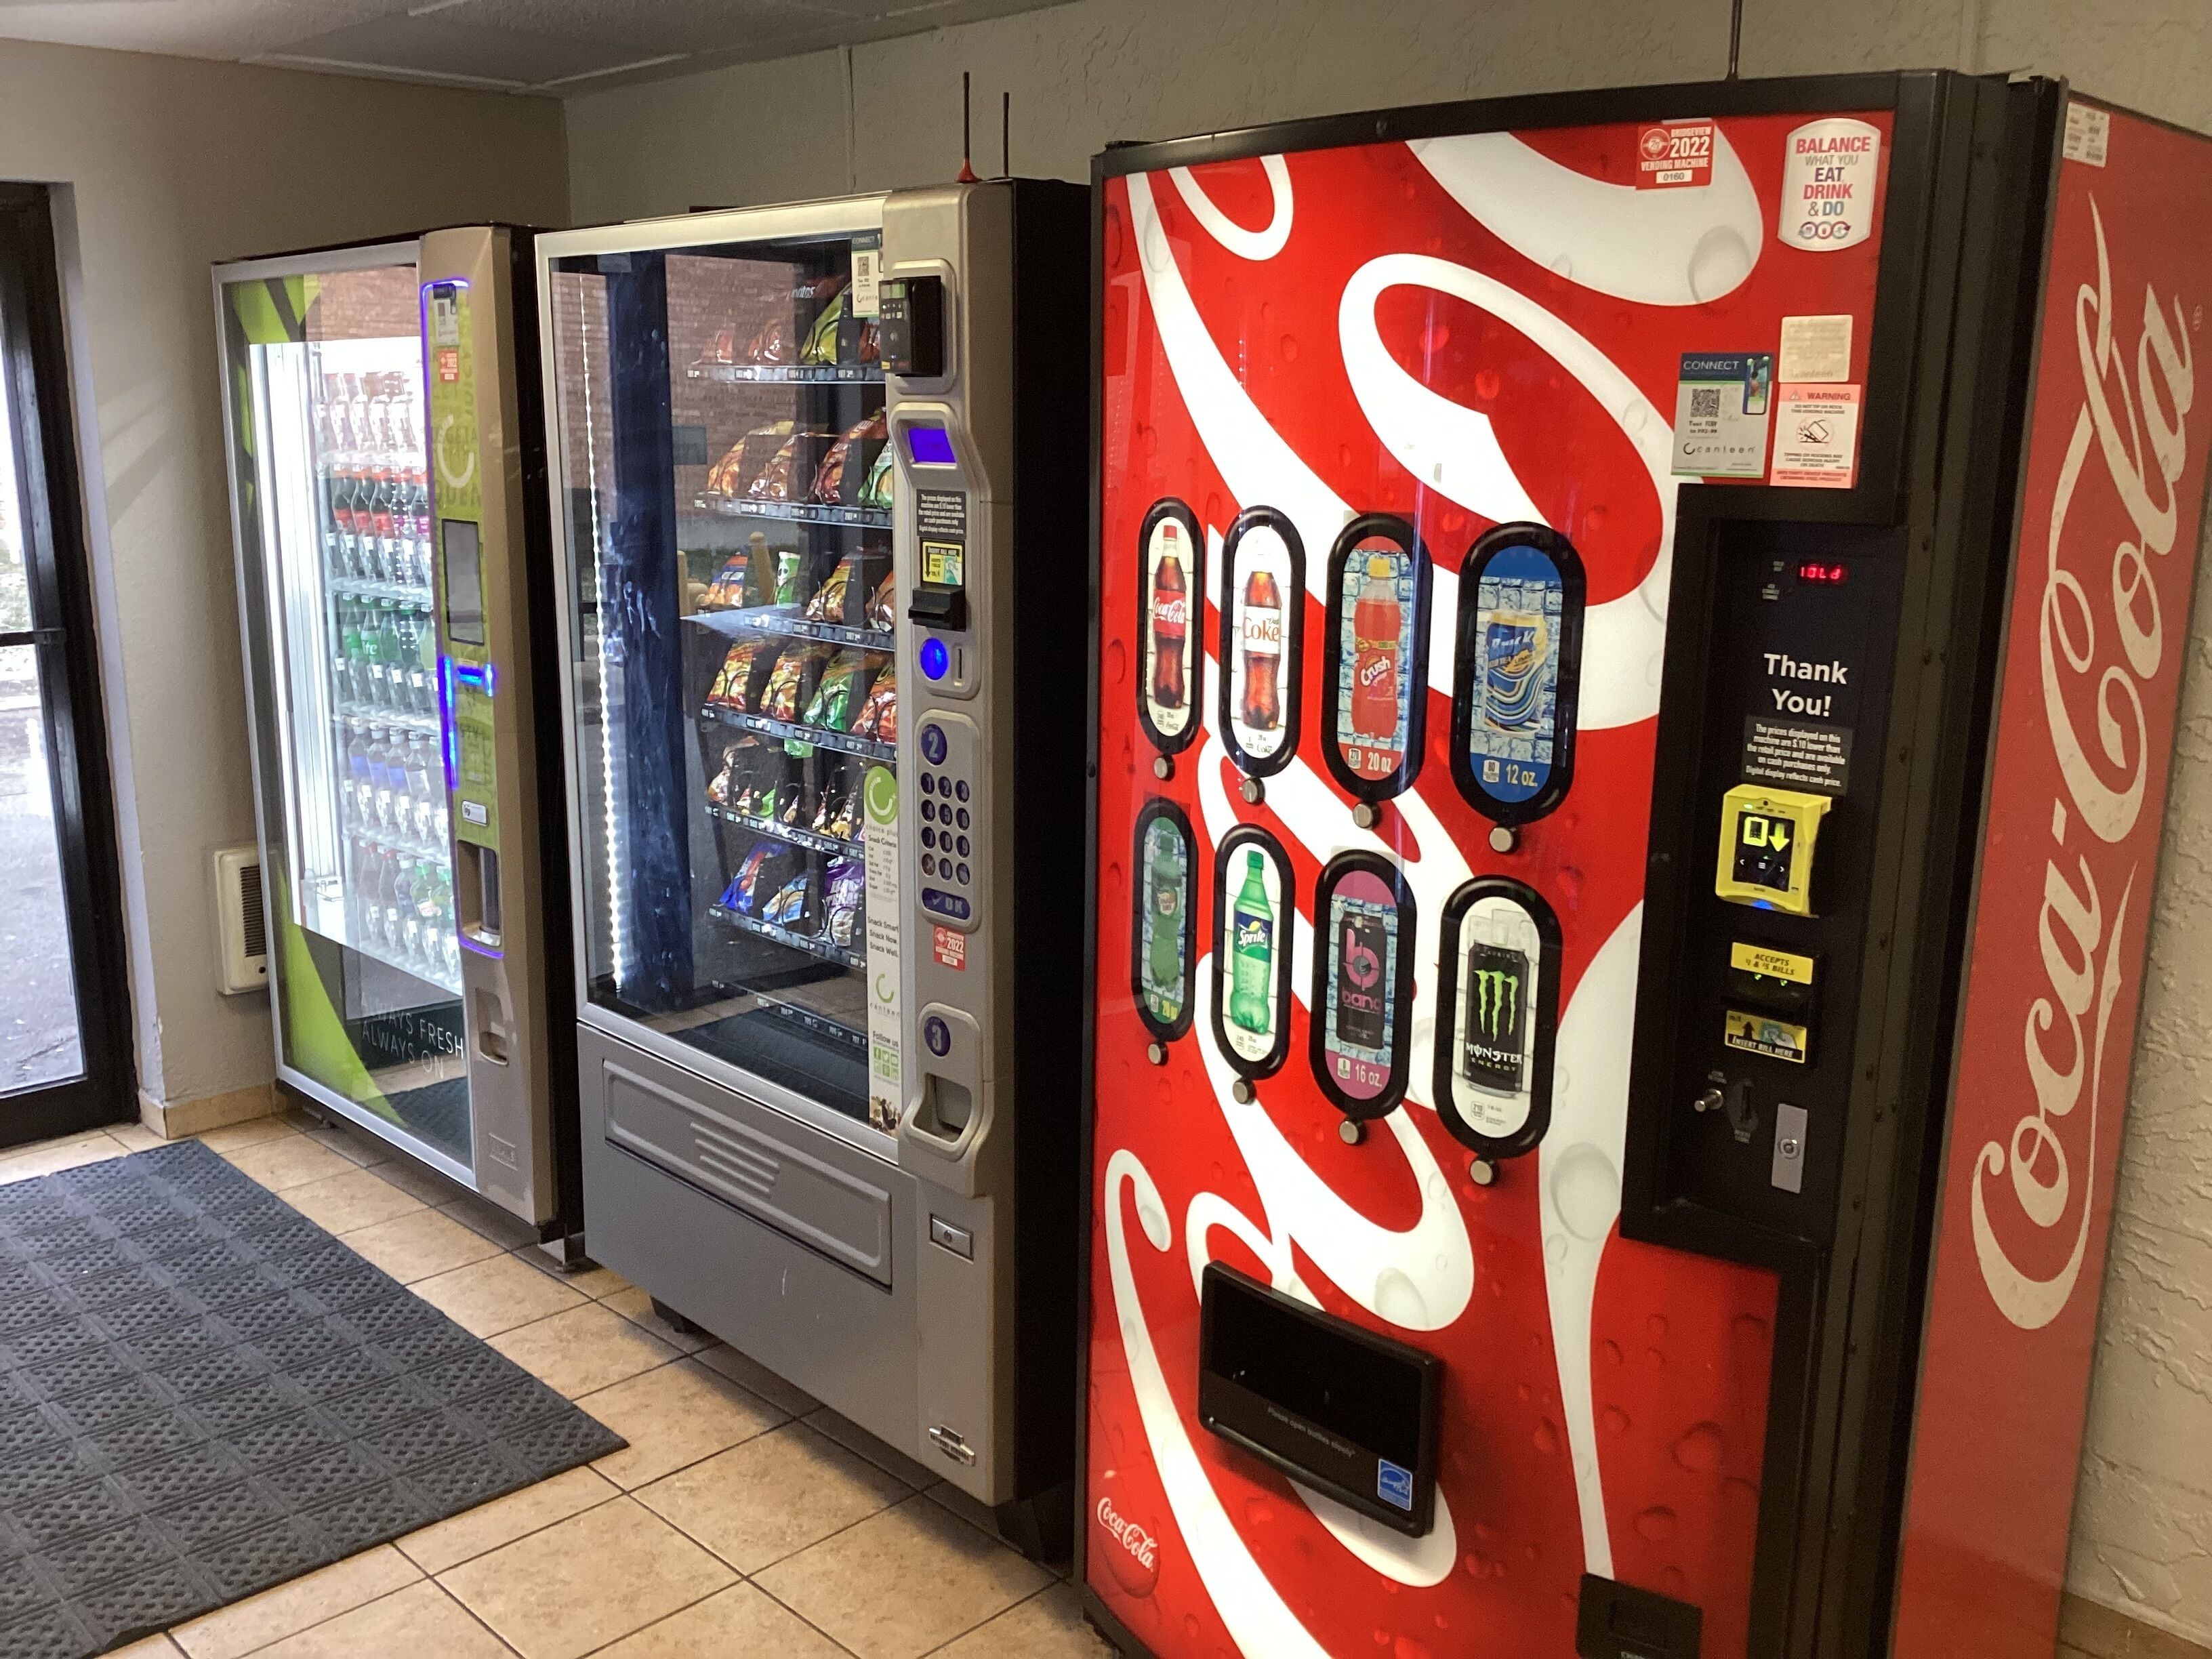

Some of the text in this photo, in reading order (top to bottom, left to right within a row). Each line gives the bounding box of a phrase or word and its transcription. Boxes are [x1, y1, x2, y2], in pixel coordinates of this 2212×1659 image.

[1670, 136, 1710, 157] 2022
[1796, 137, 1870, 154] BALANCE
[1641, 157, 1708, 171] VENDING MACHINE
[1805, 155, 1859, 166] WHAT YOU
[1663, 173, 1685, 181] 0160
[1815, 167, 1845, 182] EAT
[1803, 184, 1853, 199] DRINK
[1808, 201, 1844, 216] & DO
[1683, 361, 1740, 371] CONNECT
[1807, 392, 1851, 401] WARNING
[1243, 617, 1280, 642] Coke
[1360, 655, 1391, 687] Crush
[1763, 653, 1848, 685] Thank
[1771, 689, 1831, 717] You!
[928, 732, 939, 758] 2
[1368, 752, 1378, 771] 20
[1971, 190, 2194, 1330] Coca-Cola
[1506, 764, 1519, 785] 12
[945, 897, 963, 914] OK
[867, 916, 882, 927] Snack
[869, 929, 884, 941] Snack
[1238, 929, 1266, 947] Sprite
[869, 941, 884, 953] Snack
[947, 937, 964, 954] 2022
[1755, 953, 1790, 966] ACCEPTS
[1771, 964, 1795, 975] BILLS
[419, 1018, 464, 1059] FRESH
[873, 1030, 891, 1044] Follow
[892, 1040, 899, 1048] us
[931, 1025, 942, 1051] 3
[1732, 1036, 1757, 1048] INSERT
[1759, 1044, 1773, 1054] BILL
[362, 1019, 445, 1080] ALWAYS ON
[1466, 1042, 1523, 1065] MONSTER
[1355, 1063, 1366, 1083] 16
[1097, 1496, 1158, 1573] Coca-Cola
